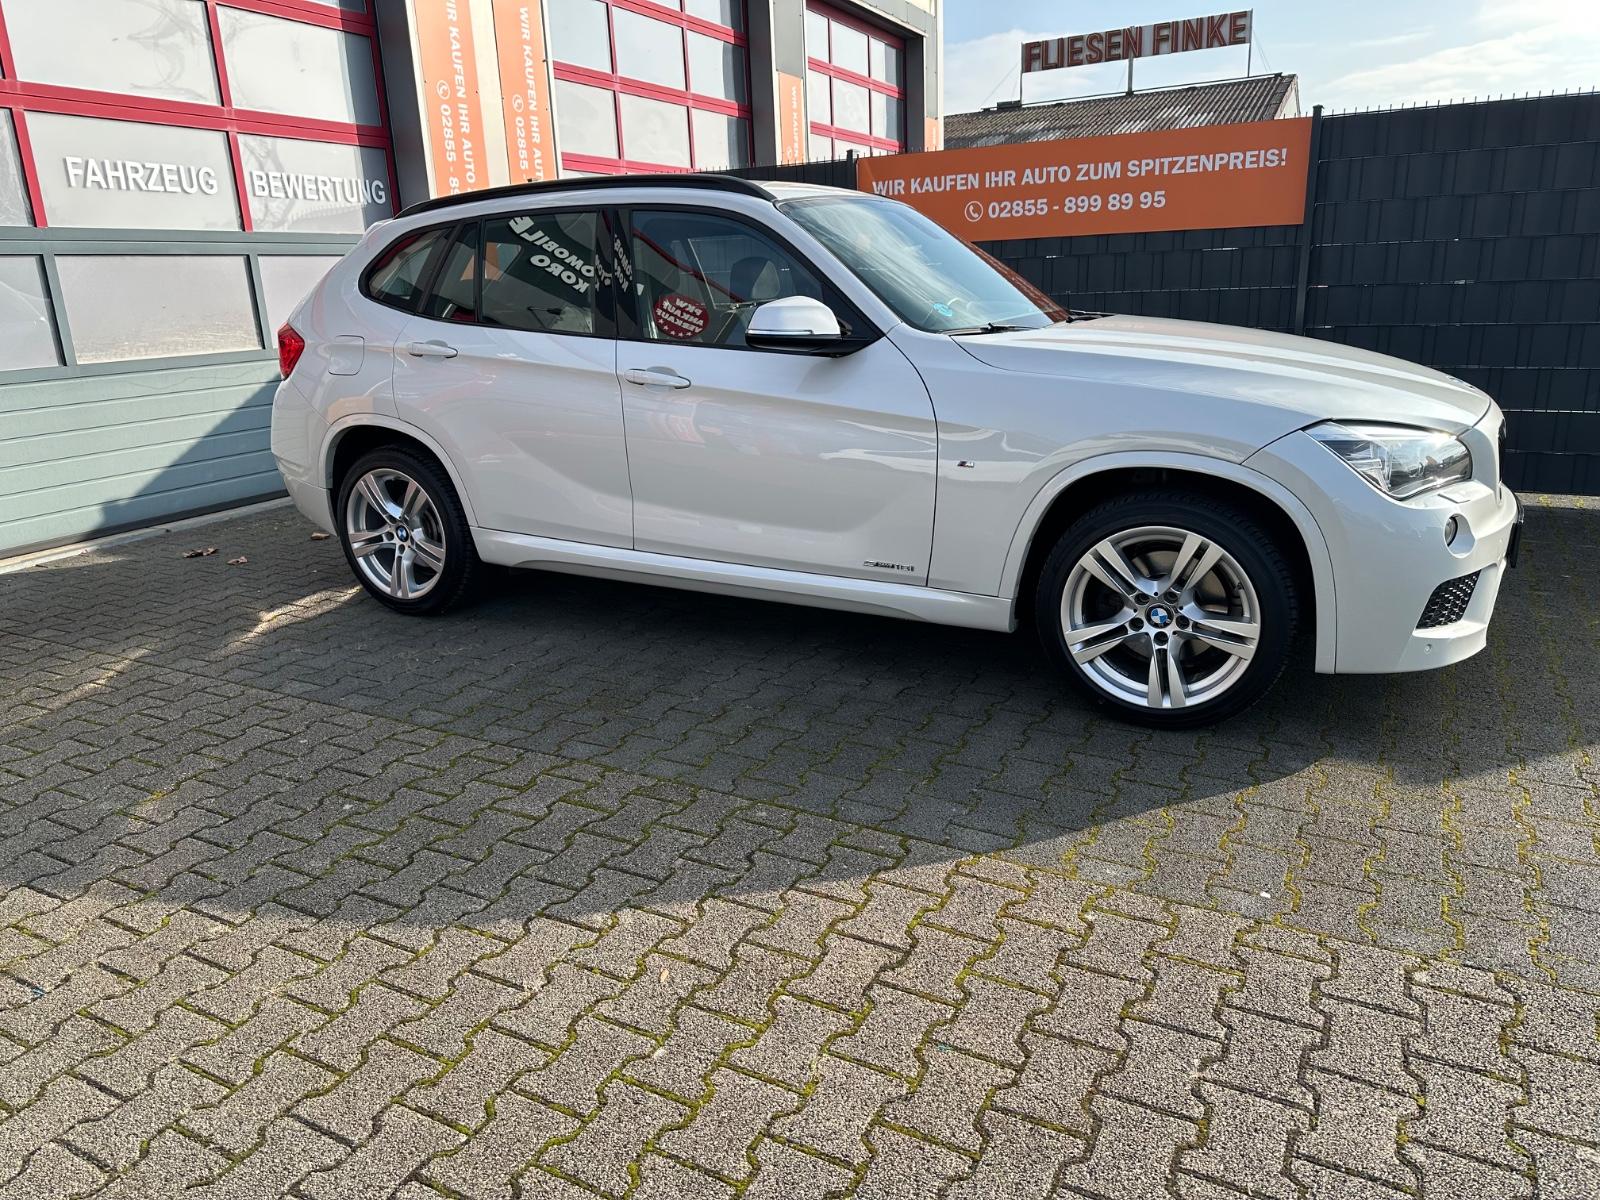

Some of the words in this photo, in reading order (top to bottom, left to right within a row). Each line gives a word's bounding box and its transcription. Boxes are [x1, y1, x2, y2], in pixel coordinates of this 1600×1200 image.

[519, 7, 531, 40] WIR
[1023, 26, 1142, 72] FLIESEN
[1152, 11, 1247, 55] FINKE
[449, 26, 467, 98] KAUFEN
[523, 45, 537, 110] KAUFEN
[440, 104, 456, 162] 02855
[458, 103, 471, 134] IHR
[530, 115, 541, 144] IHR
[462, 138, 476, 183] AUTO
[515, 116, 528, 170] 02855
[533, 147, 544, 181] AUT
[64, 156, 218, 195] FAHRZEUG
[251, 170, 386, 204] BEWERTUNG
[872, 181, 905, 196] WIR
[910, 173, 979, 194] KAUFEN
[985, 170, 1016, 188] IHR
[1021, 165, 1071, 185] AUTO
[1076, 161, 1121, 181] ZUM
[1127, 148, 1288, 177] SPITZENPREIS!
[988, 199, 1048, 219] 02855
[1064, 195, 1101, 213] 899
[1108, 193, 1133, 211] 89
[1140, 190, 1166, 208] 95
